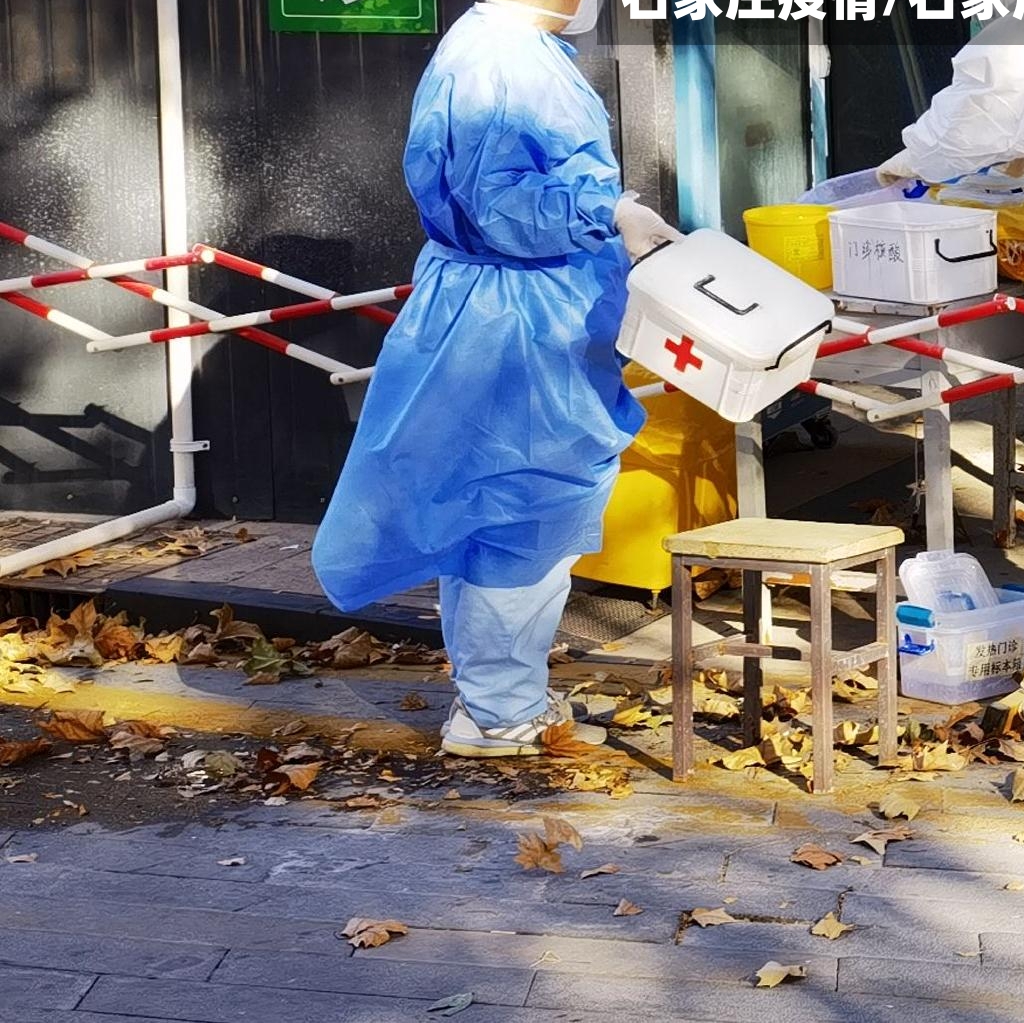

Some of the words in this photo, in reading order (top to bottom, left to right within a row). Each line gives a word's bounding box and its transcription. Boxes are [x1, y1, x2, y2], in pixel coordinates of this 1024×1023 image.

[848, 239, 904, 263] 门诊核酸
[975, 639, 1018, 658] 发热门诊
